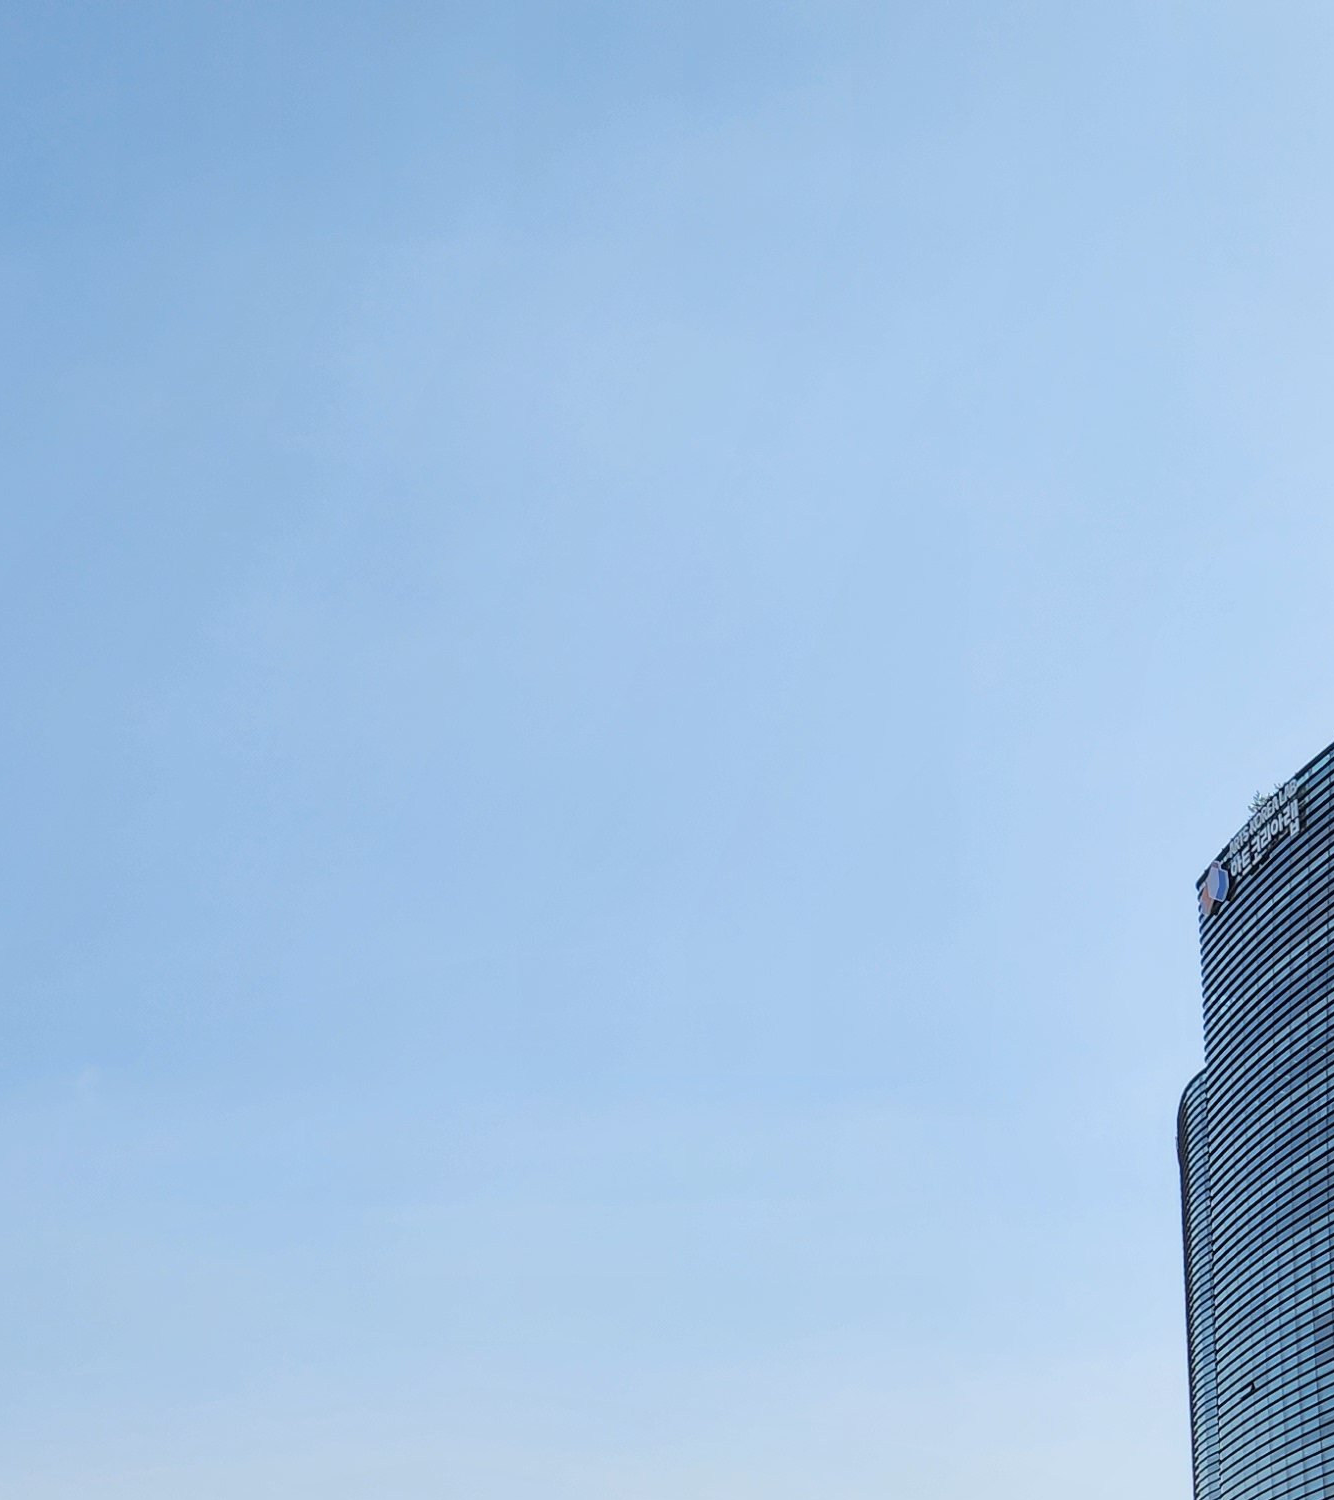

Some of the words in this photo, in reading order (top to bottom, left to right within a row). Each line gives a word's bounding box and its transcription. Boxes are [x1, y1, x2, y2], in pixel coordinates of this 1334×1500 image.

[1228, 825, 1249, 858] ARTS
[1249, 795, 1280, 835] KOREA
[1279, 778, 1299, 804] LAB
[1230, 798, 1301, 878] 아트코리아랩
